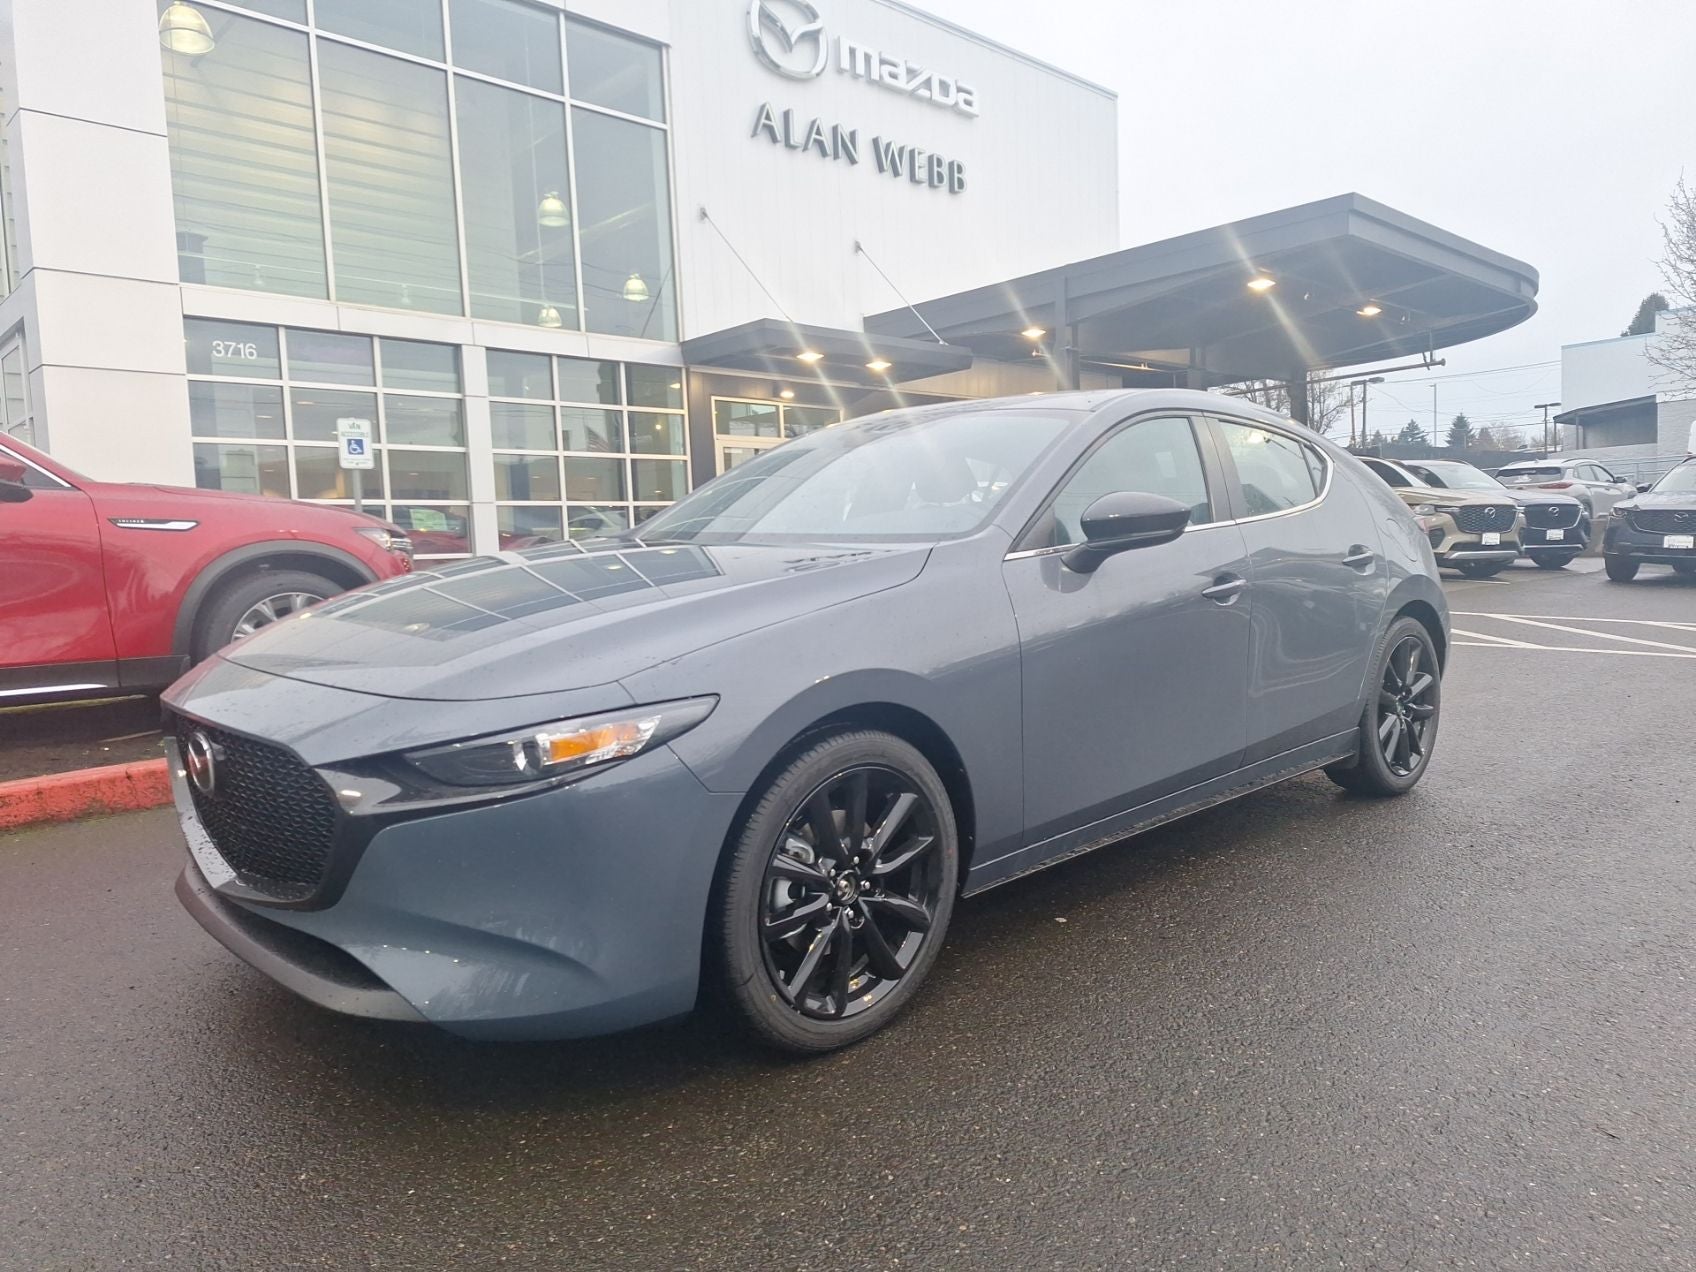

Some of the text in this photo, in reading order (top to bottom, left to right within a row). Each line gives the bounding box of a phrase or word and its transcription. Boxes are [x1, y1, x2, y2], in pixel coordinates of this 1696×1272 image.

[751, 101, 967, 194] ALAN WEBB
[212, 341, 257, 359] 3716
